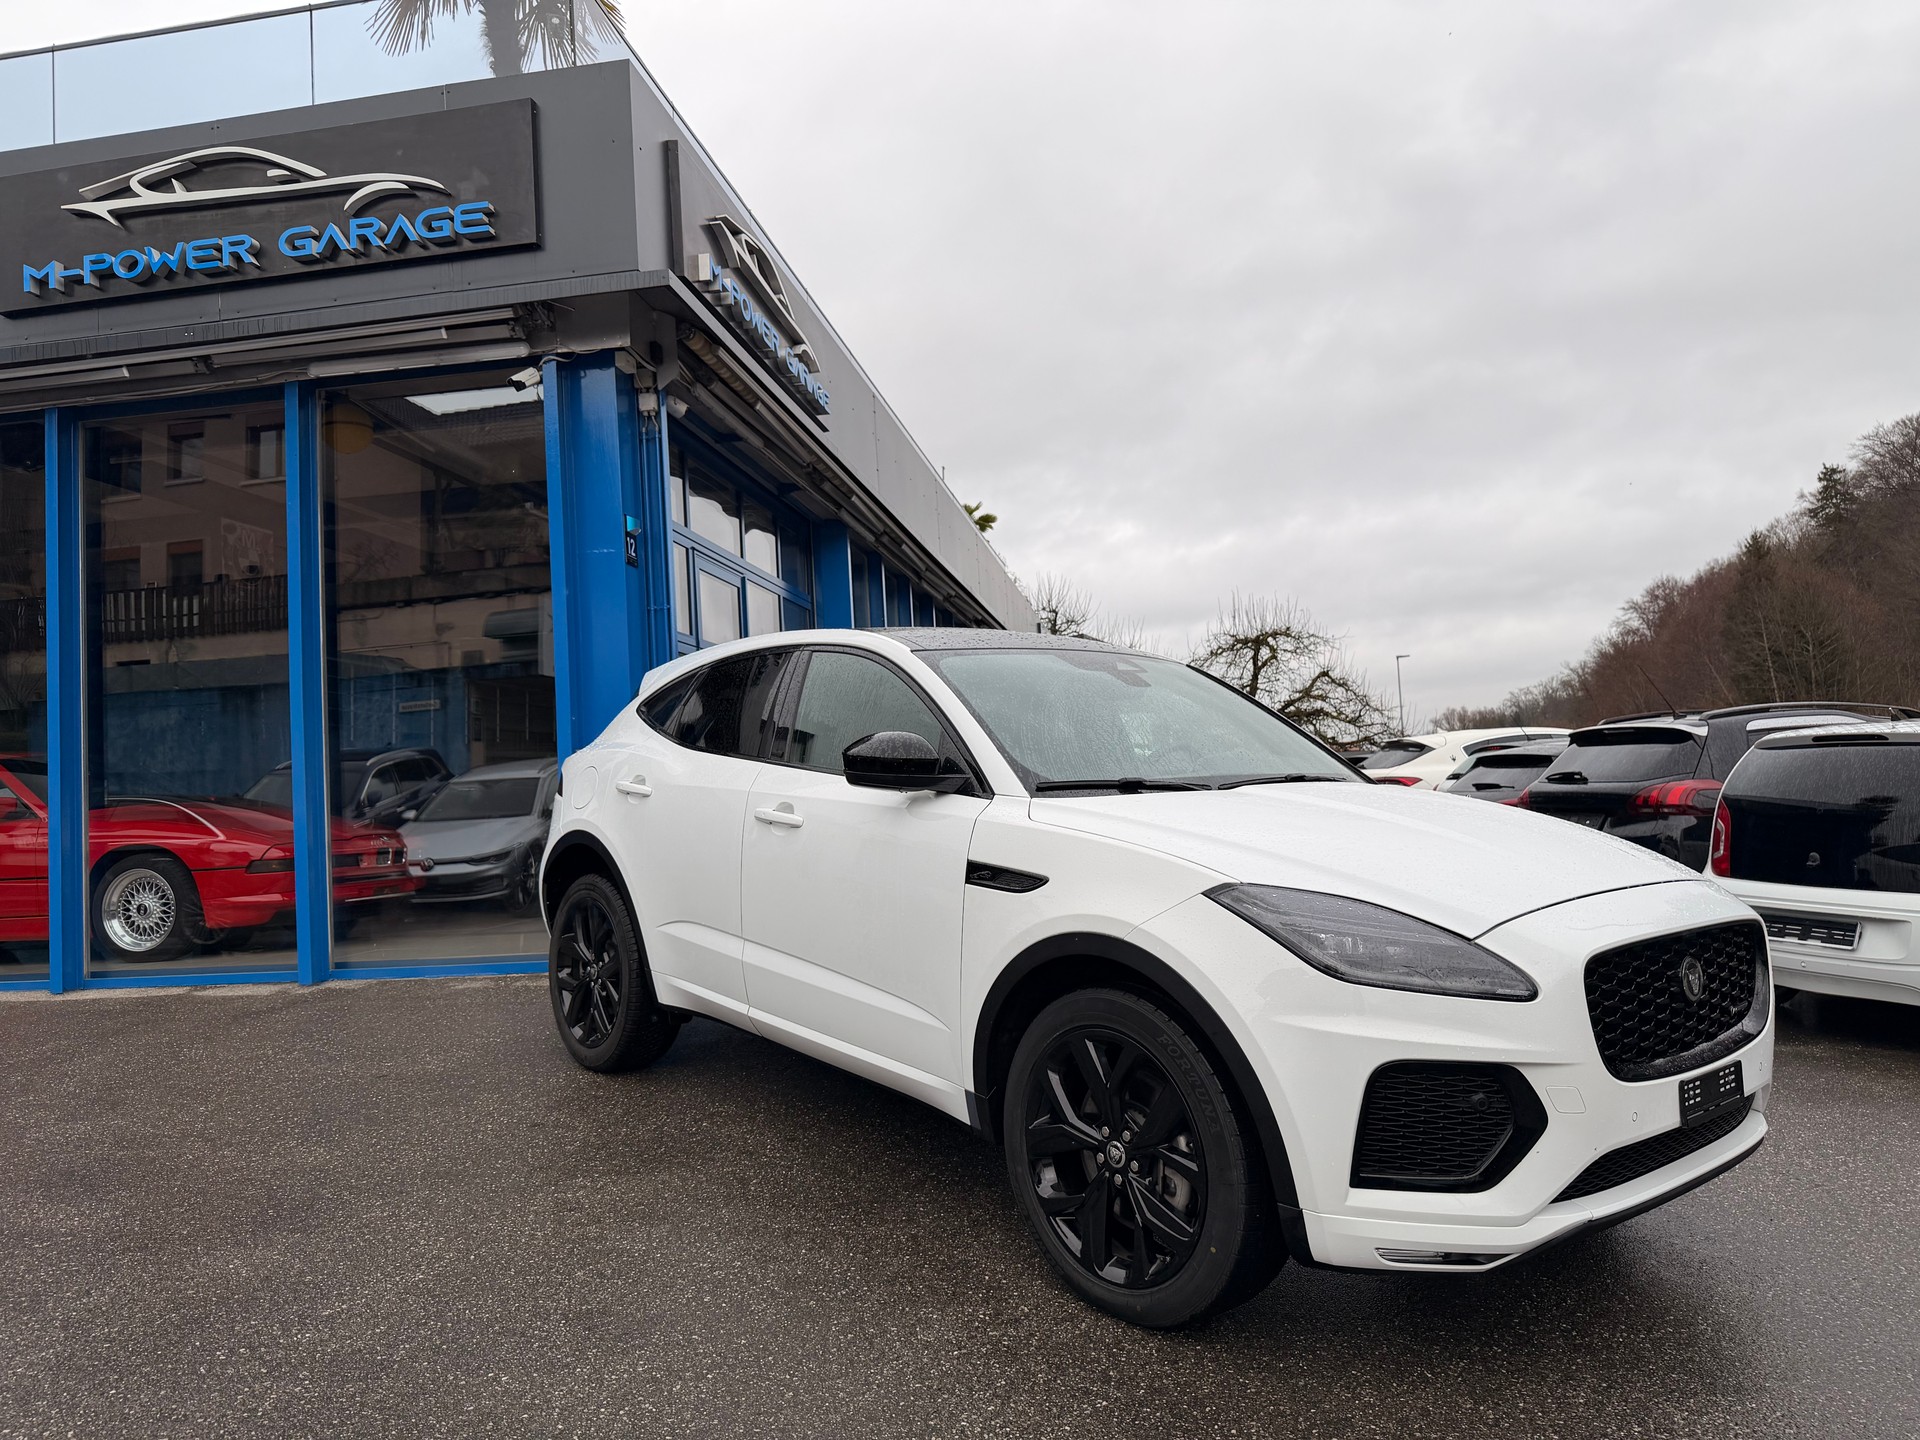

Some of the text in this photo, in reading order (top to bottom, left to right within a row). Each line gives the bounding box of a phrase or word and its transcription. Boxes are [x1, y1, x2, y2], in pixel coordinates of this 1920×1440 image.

[23, 201, 494, 294] M-POWER GARAGE
[710, 256, 831, 414] M-POWER GARAGE
[627, 536, 636, 557] 12
[1156, 1033, 1221, 1135] FORTUNA
